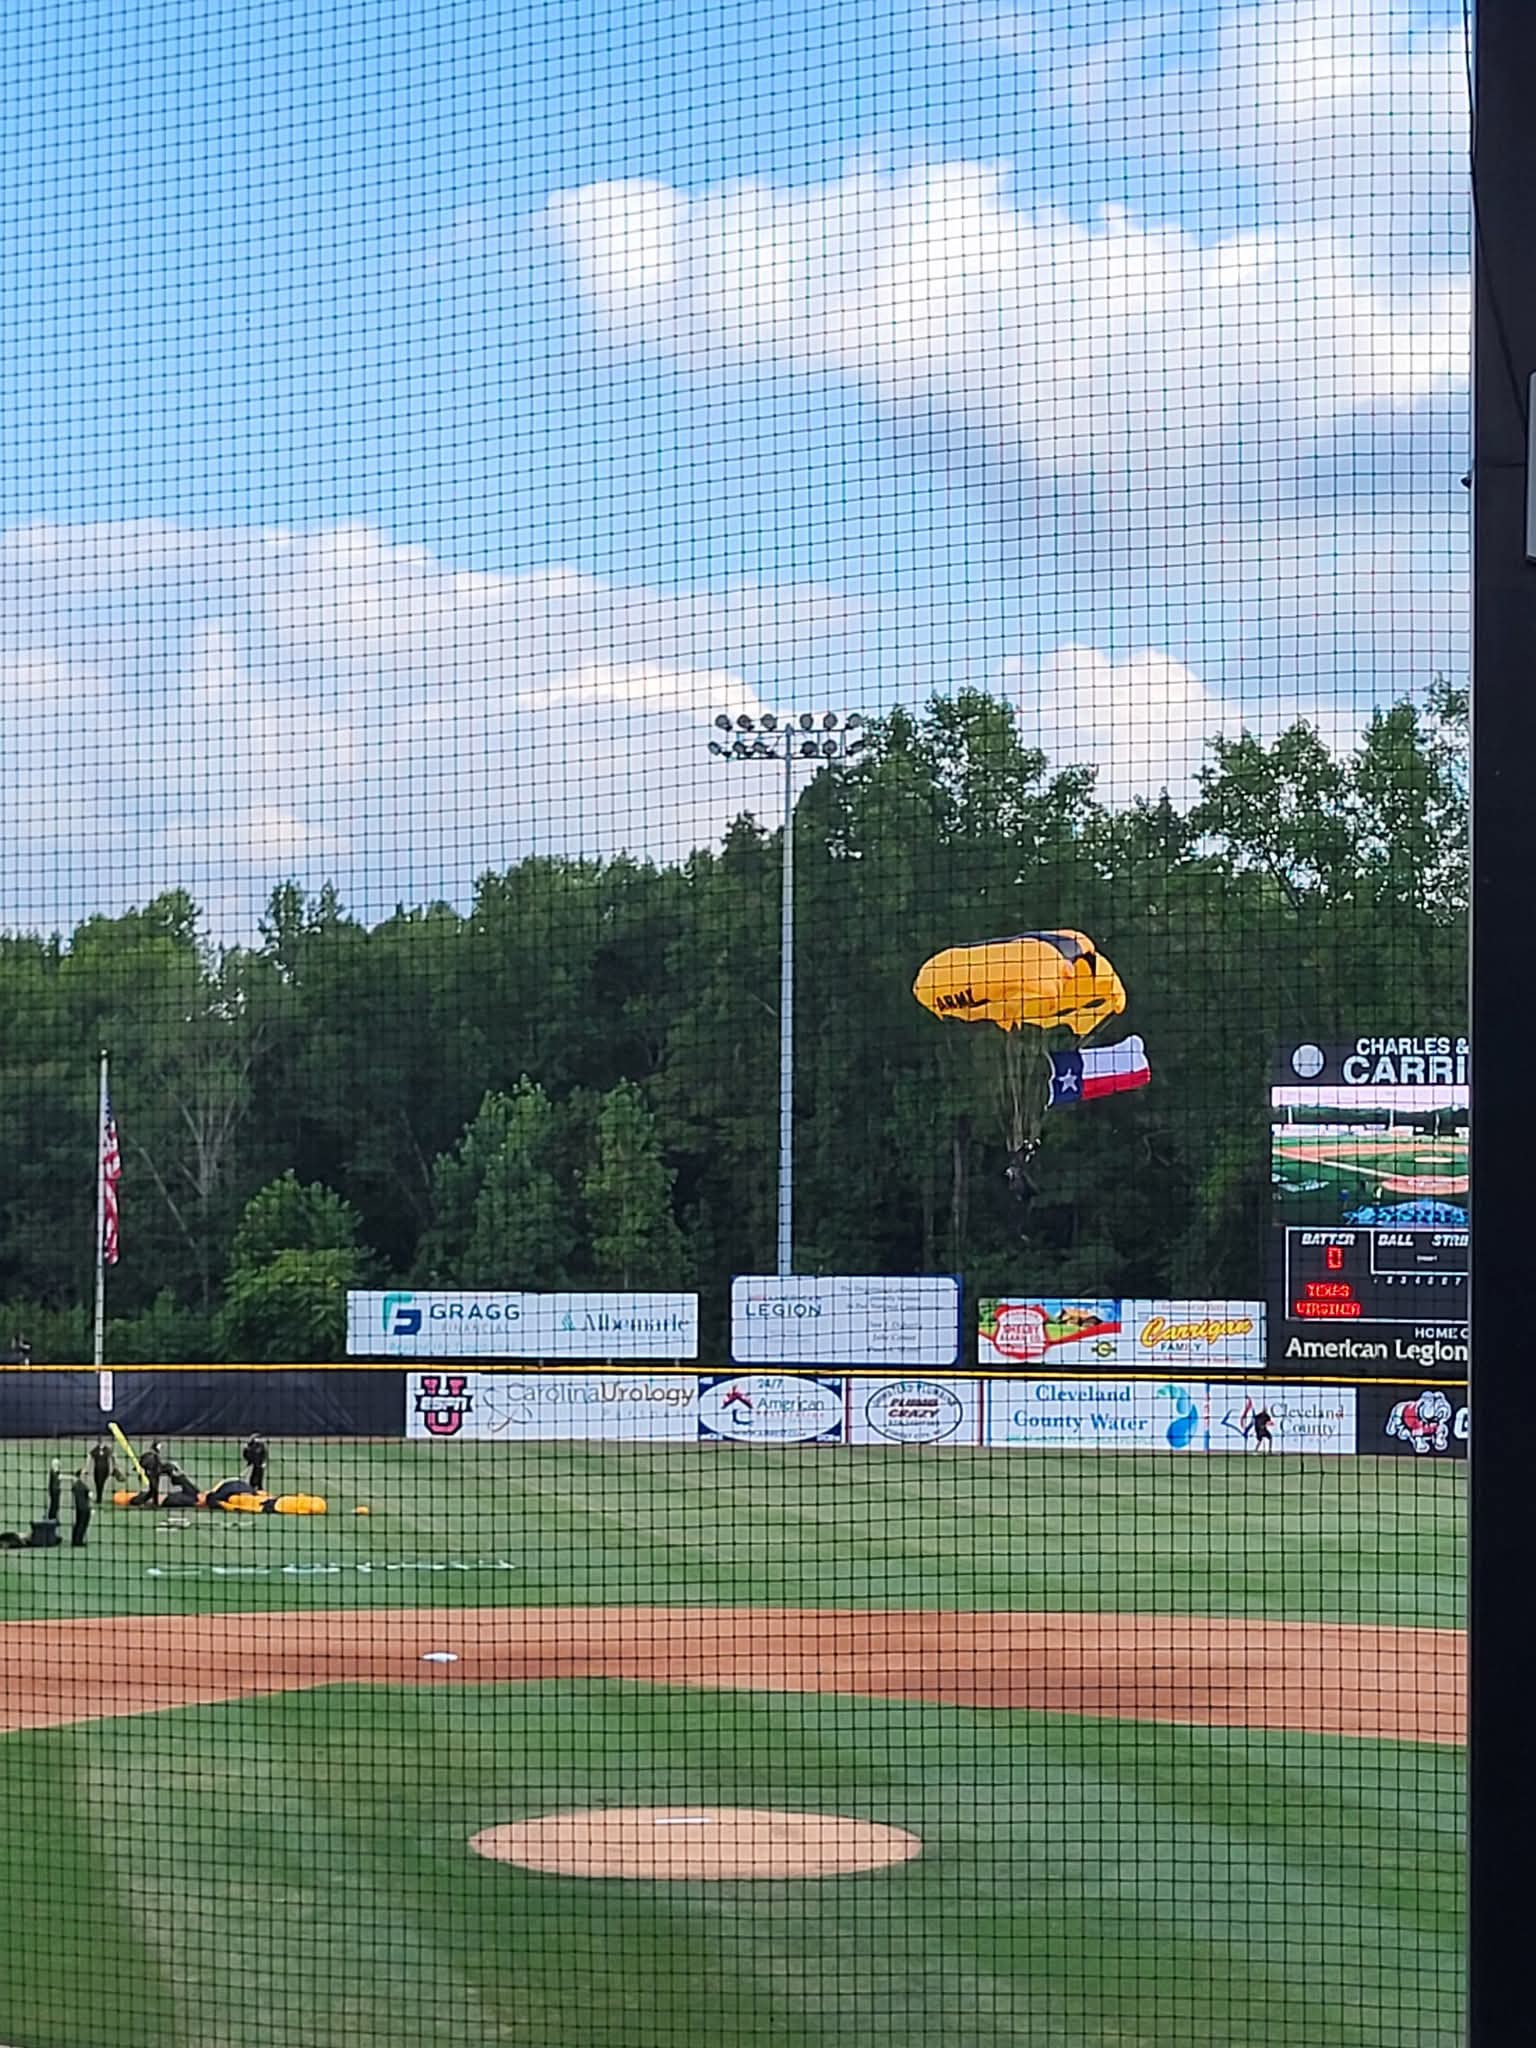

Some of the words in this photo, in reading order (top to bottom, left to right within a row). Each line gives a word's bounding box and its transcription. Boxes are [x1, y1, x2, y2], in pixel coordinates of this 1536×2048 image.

[936, 987, 975, 1012] ARMY
[1356, 1037, 1450, 1056] CHARLES
[1342, 1055, 1466, 1085] CARRI
[1301, 1232, 1356, 1246] BATTER
[1378, 1233, 1414, 1247] BALL
[430, 1303, 520, 1320] GRAGG
[746, 1303, 822, 1318] LEGION
[1296, 1302, 1361, 1316] VIRGINIA
[583, 1313, 690, 1332] Albemarle
[1141, 1317, 1253, 1347] Carrigan
[1415, 1327, 1458, 1339] HOME
[1160, 1342, 1202, 1352] FAMILY
[1285, 1337, 1388, 1358] American
[1395, 1339, 1468, 1367] Legion
[758, 1378, 784, 1390] 24/7
[1035, 1384, 1132, 1402] Cleveland
[757, 1396, 824, 1412] American
[1270, 1402, 1344, 1419] Cleveland
[888, 1408, 939, 1418] CRAZY
[1013, 1409, 1083, 1433] County
[1089, 1413, 1148, 1431] Water
[1279, 1418, 1336, 1440] County
